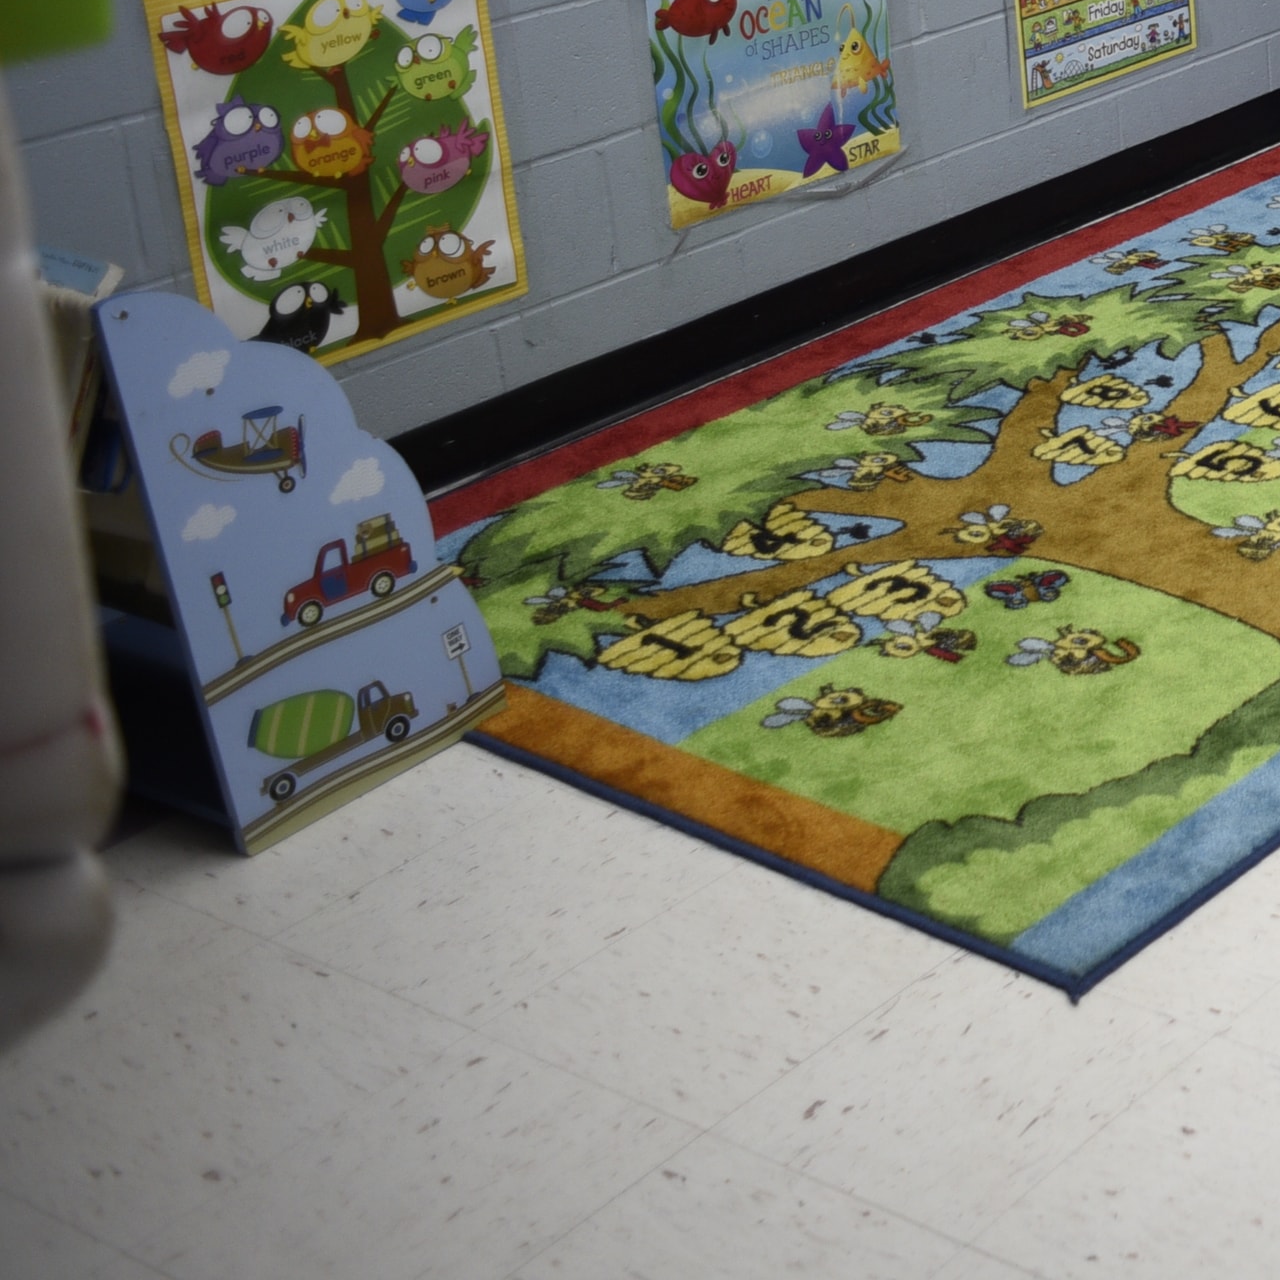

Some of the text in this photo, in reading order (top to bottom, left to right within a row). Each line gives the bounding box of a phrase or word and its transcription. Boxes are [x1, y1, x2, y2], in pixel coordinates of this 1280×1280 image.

[320, 30, 363, 55] yellow
[745, 25, 831, 61] of SHAPES
[1086, 33, 1141, 64] Saturday
[413, 67, 453, 92] green
[223, 142, 272, 171] purple
[308, 145, 358, 168] orange
[848, 138, 881, 163] STAR
[423, 167, 451, 191] pink
[262, 234, 301, 257] white
[426, 265, 467, 290] brown
